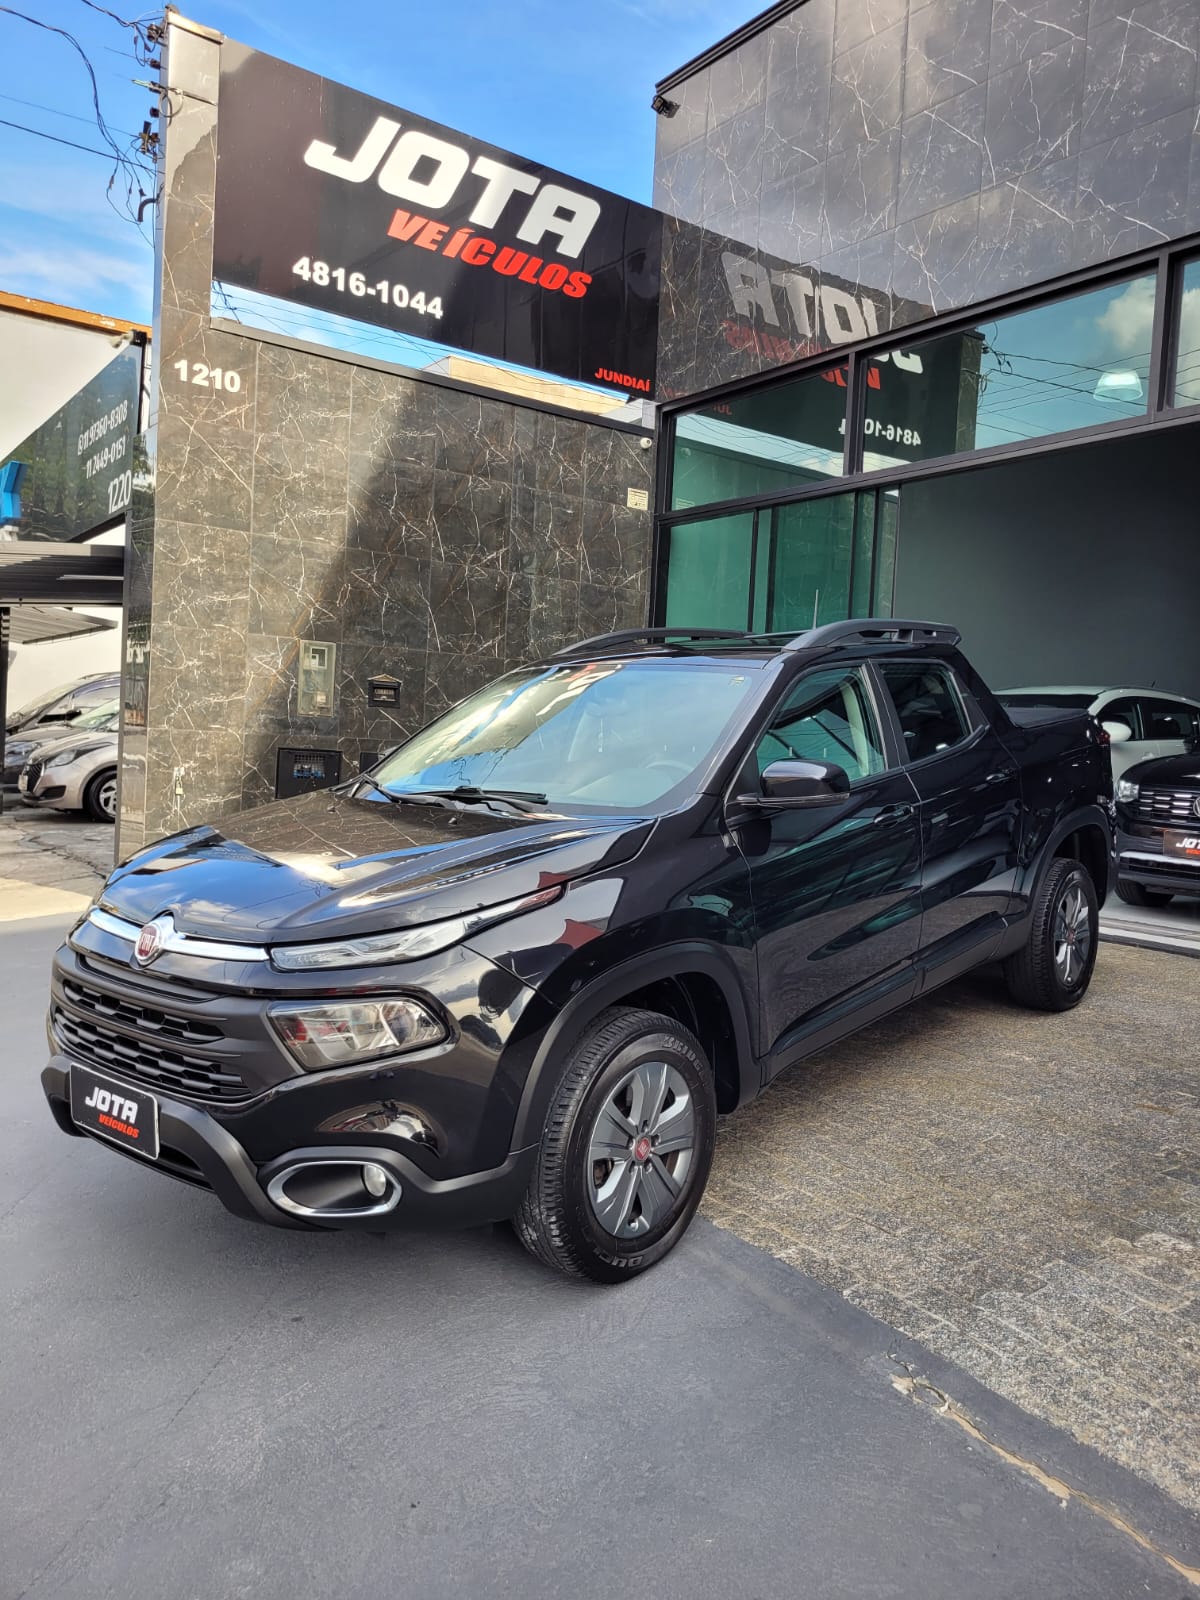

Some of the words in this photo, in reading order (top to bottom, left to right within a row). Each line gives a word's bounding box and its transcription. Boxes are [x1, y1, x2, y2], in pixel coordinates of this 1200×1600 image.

[304, 116, 601, 259] JOTA
[387, 209, 592, 298] VEÍCULOS
[292, 256, 444, 320] 4816-1044
[174, 359, 241, 393] 1210
[594, 367, 650, 393] JUNDIAÍ
[108, 469, 132, 514] 1220
[1175, 837, 1200, 849] JO
[85, 1086, 138, 1124] JOTA
[98, 1113, 139, 1139] VEÍCULOS
